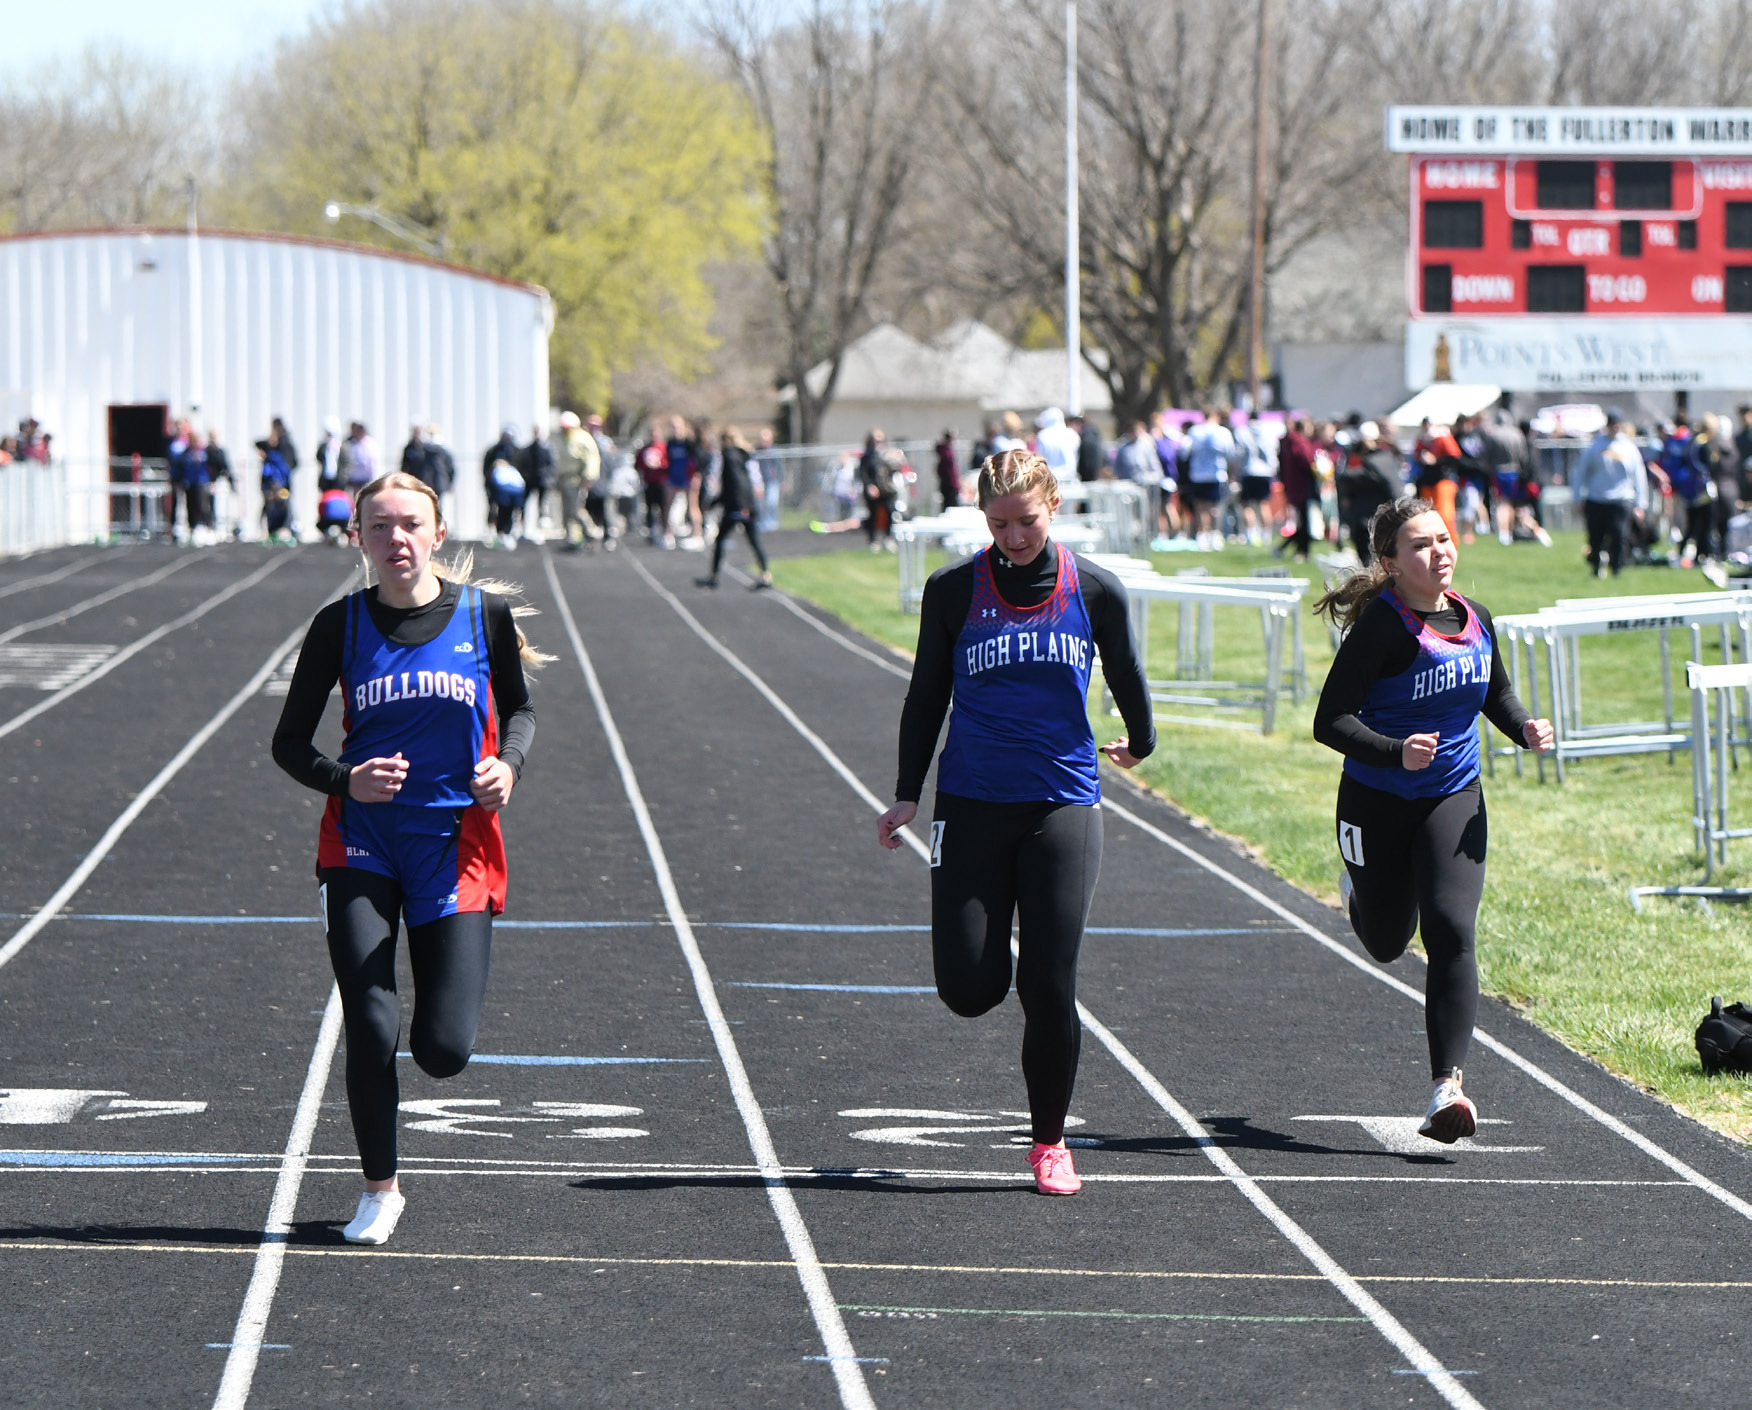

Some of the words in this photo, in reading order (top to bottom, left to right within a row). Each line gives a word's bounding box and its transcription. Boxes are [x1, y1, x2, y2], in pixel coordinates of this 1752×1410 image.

[1400, 117, 1460, 141] HOME
[1474, 117, 1496, 141] OF
[1512, 117, 1548, 142] THE
[1561, 118, 1674, 143] FULLERTON
[1452, 275, 1514, 302] DOWN
[966, 635, 1011, 676] HIGH
[1018, 632, 1088, 670] PLAINS
[356, 671, 475, 711] BULLDOGS
[1412, 657, 1457, 700] HIGH
[930, 823, 939, 865] 2
[1345, 827, 1356, 861] 1
